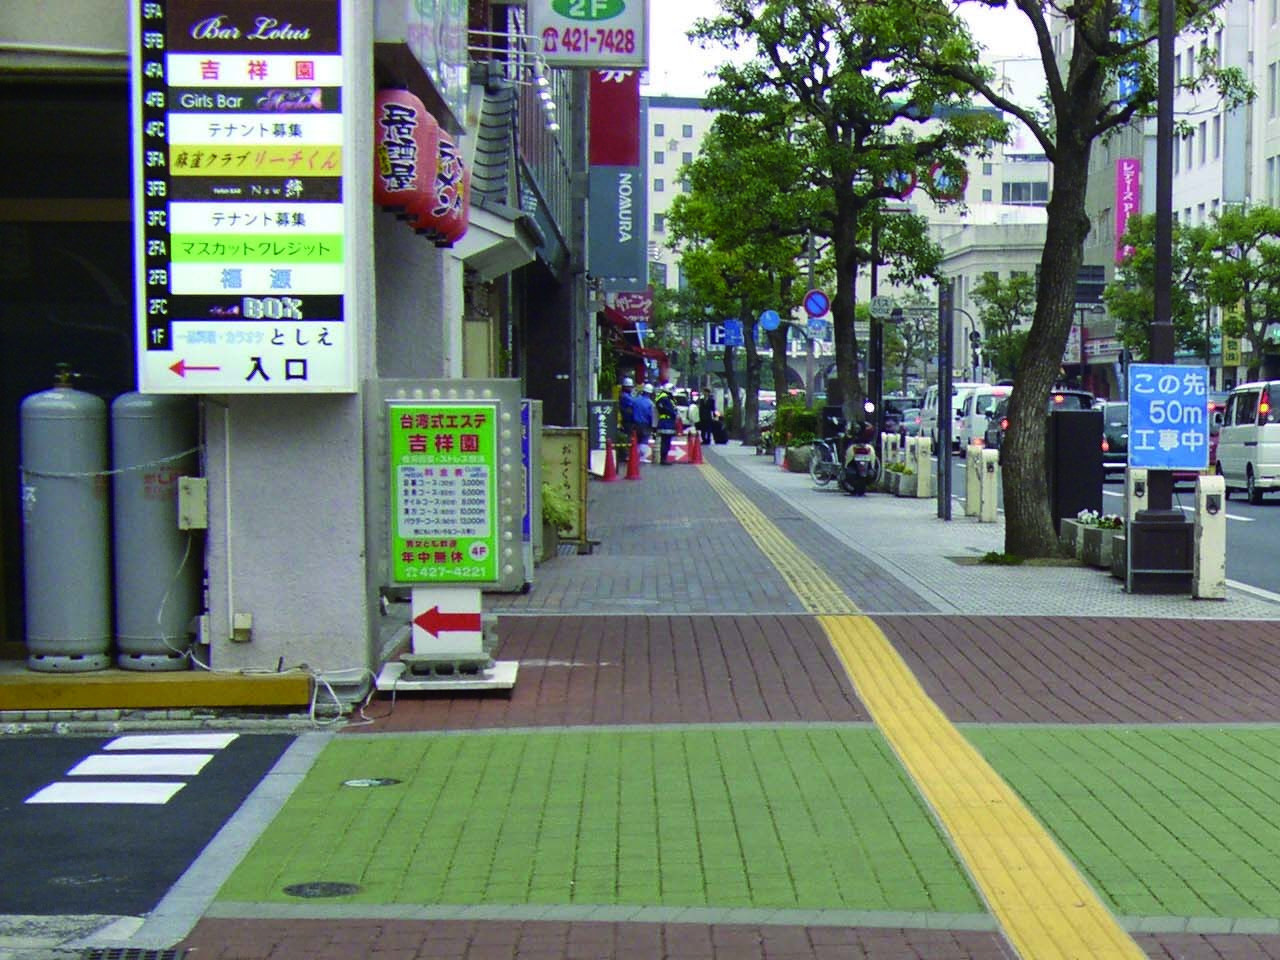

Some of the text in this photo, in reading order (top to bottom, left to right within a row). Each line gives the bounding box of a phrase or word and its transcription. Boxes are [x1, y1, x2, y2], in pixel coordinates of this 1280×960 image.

[144, 3, 162, 18] 5FA
[569, 0, 608, 17] 2F
[192, 16, 311, 40] Bar Lotus
[144, 32, 163, 48] 5FB
[562, 27, 634, 53] 421-7428
[144, 62, 163, 78] 4FA
[200, 60, 315, 80] 吉祥園
[145, 91, 164, 107] 4FB
[181, 94, 213, 108] Girls
[217, 94, 243, 108] Bar
[145, 121, 165, 137] 4FC
[208, 122, 303, 138] テナント募集
[146, 151, 165, 167] 3FA
[147, 181, 166, 197] 3FB
[619, 173, 632, 242] NOMURA
[147, 211, 167, 227] 3FC
[212, 211, 306, 227] テナント募集
[148, 240, 166, 256] 2FA
[183, 241, 331, 257] マスカットクレジット
[148, 269, 168, 285] 2FB
[149, 298, 168, 315] 2FC
[243, 297, 303, 320] BOX
[152, 329, 164, 344] 1F
[271, 328, 333, 346] としえ
[245, 356, 308, 381] 入口
[1134, 373, 1205, 395] この先
[1149, 400, 1202, 424] 50m
[1133, 428, 1204, 452] 工事中
[471, 546, 486, 555] 4F
